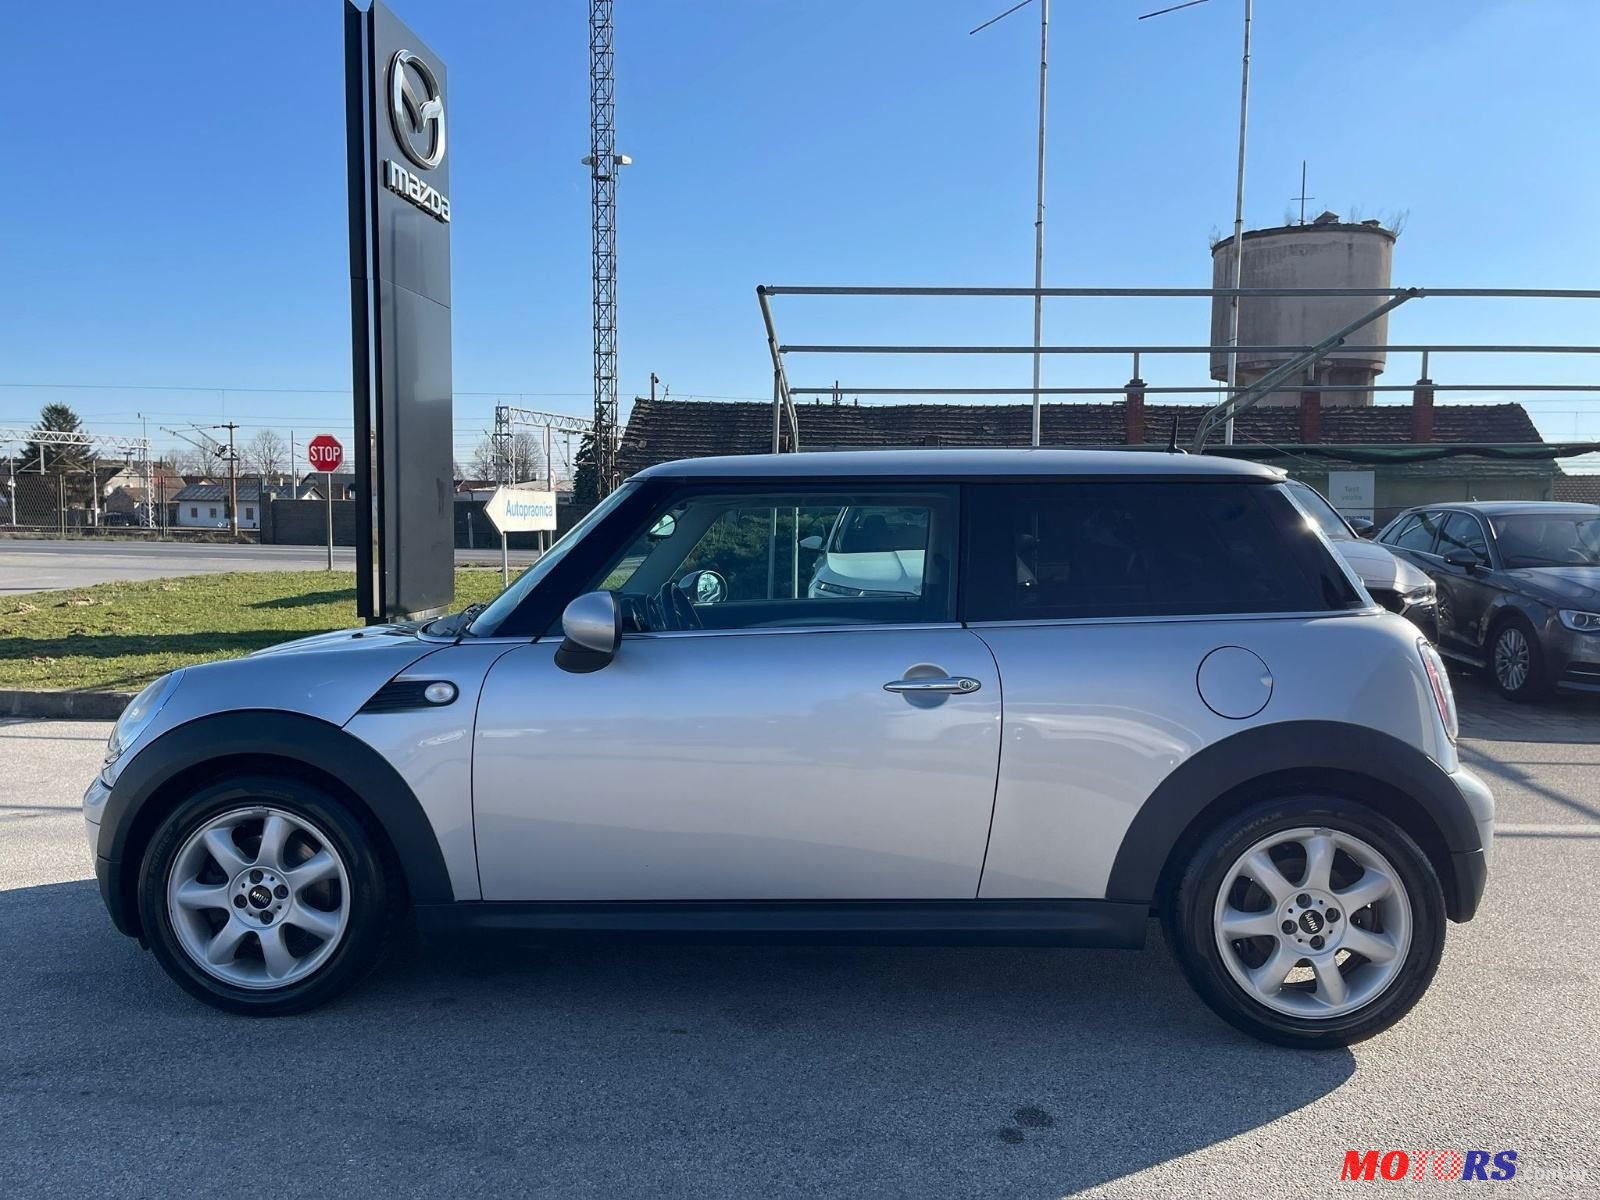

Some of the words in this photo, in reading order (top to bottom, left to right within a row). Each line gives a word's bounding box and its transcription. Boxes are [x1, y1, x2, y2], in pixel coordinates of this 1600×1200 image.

[310, 445, 340, 462] STOP
[505, 499, 553, 520] Autopraonica
[1304, 913, 1319, 932] MINI
